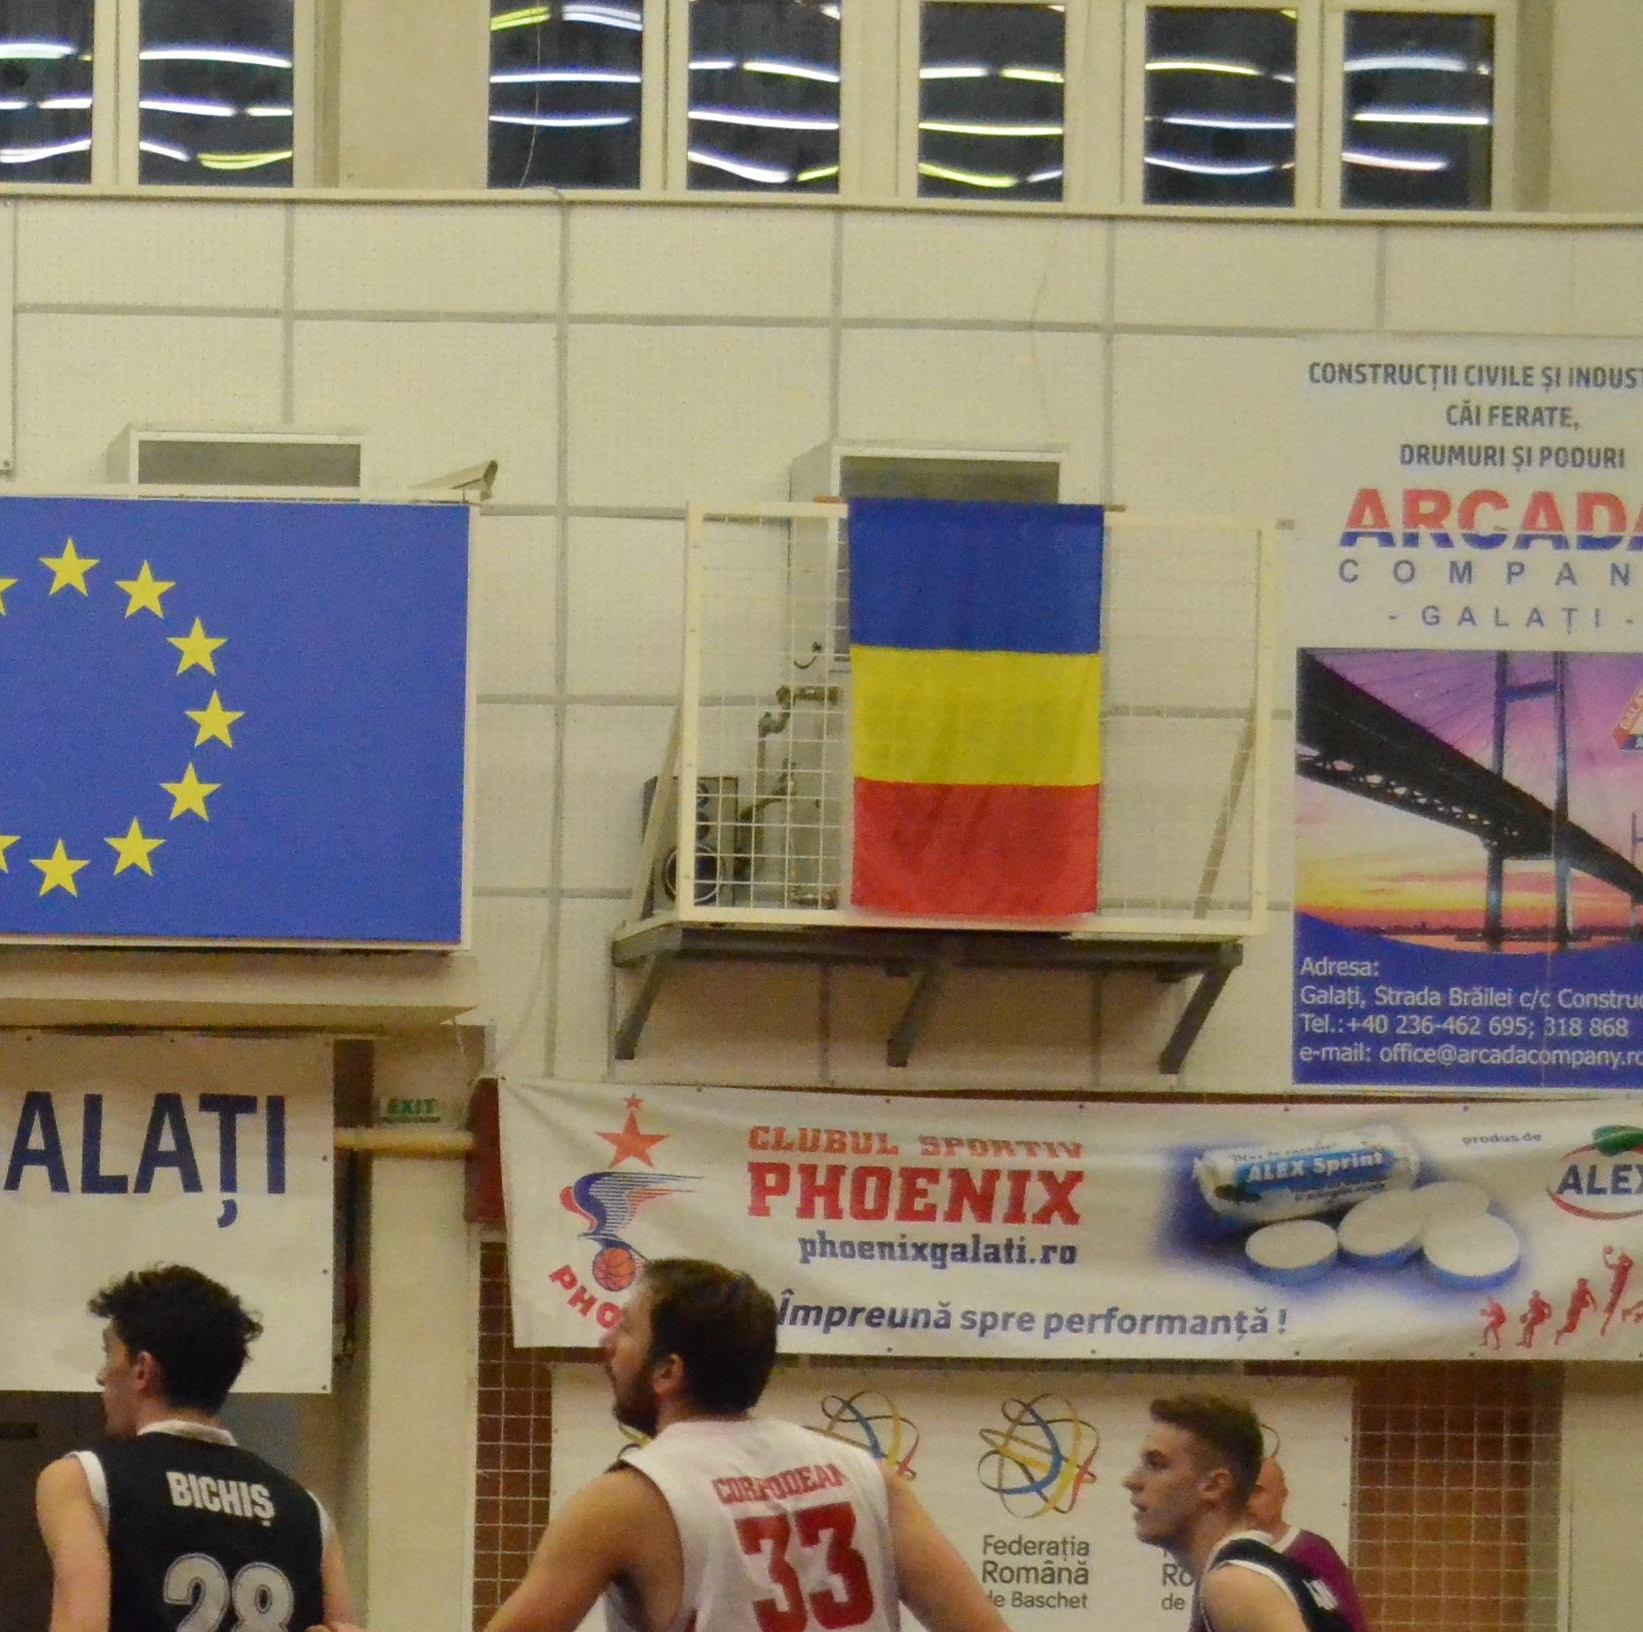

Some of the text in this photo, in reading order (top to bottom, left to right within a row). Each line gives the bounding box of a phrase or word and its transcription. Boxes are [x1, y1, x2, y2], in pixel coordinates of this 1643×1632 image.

[1308, 362, 1457, 391] CONSTRUCȚII
[1465, 365, 1534, 387] CIVILE
[1541, 366, 1561, 392] ȘI
[1446, 401, 1580, 431] CĂI FERATE,
[1400, 444, 1626, 472] DRUMURI ȘI PODURI
[1300, 956, 1379, 978] Adresa:
[1300, 985, 1365, 1010] Galați,
[1374, 987, 1441, 1008] Strada
[1449, 987, 1513, 1009] Brăilei
[1520, 989, 1551, 1010] c/c
[1346, 1015, 1388, 1034] +40
[1396, 1015, 1480, 1036] 236-462
[1489, 1016, 1534, 1039] 695;
[1543, 1017, 1582, 1037] 318
[1589, 1017, 1628, 1037] 868
[1300, 1043, 1371, 1062] e-mail:
[748, 1125, 1084, 1158] CLUBUL SPORTIV
[747, 1161, 1085, 1225] PHOENIX
[1557, 1164, 1643, 1196] ALE
[798, 1230, 1077, 1269] phoenixgalati.ro
[779, 1289, 952, 1334] Împreună
[960, 1303, 1035, 1337] spre
[1044, 1306, 1268, 1341] performanță
[166, 1471, 275, 1526] BICHIȘ
[982, 1534, 1090, 1560] Federația
[982, 1560, 1090, 1585] Română
[1010, 1590, 1088, 1609] Baschet
